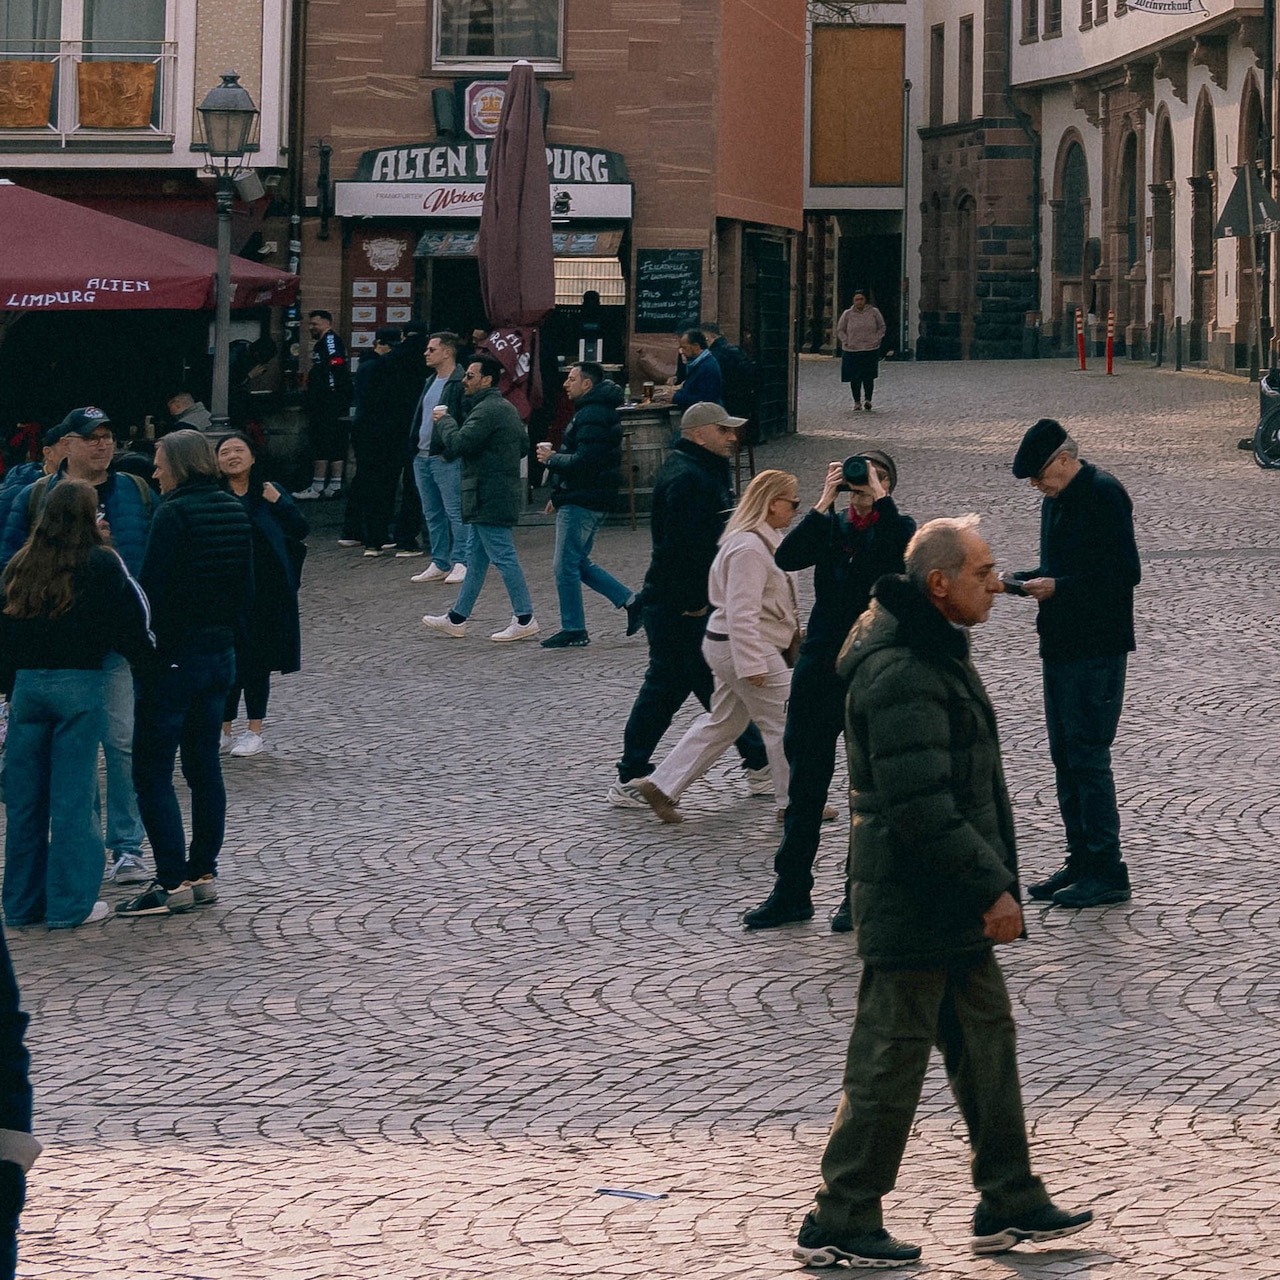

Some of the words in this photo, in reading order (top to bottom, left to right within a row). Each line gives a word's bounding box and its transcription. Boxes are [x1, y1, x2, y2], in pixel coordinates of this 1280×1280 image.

[371, 145, 467, 182] ALTEN
[475, 143, 609, 183] LPURG
[423, 187, 484, 213] Worsc
[86, 277, 151, 292] ALTEN
[6, 290, 97, 307] LIMPURG
[326, 334, 337, 356] BORA
